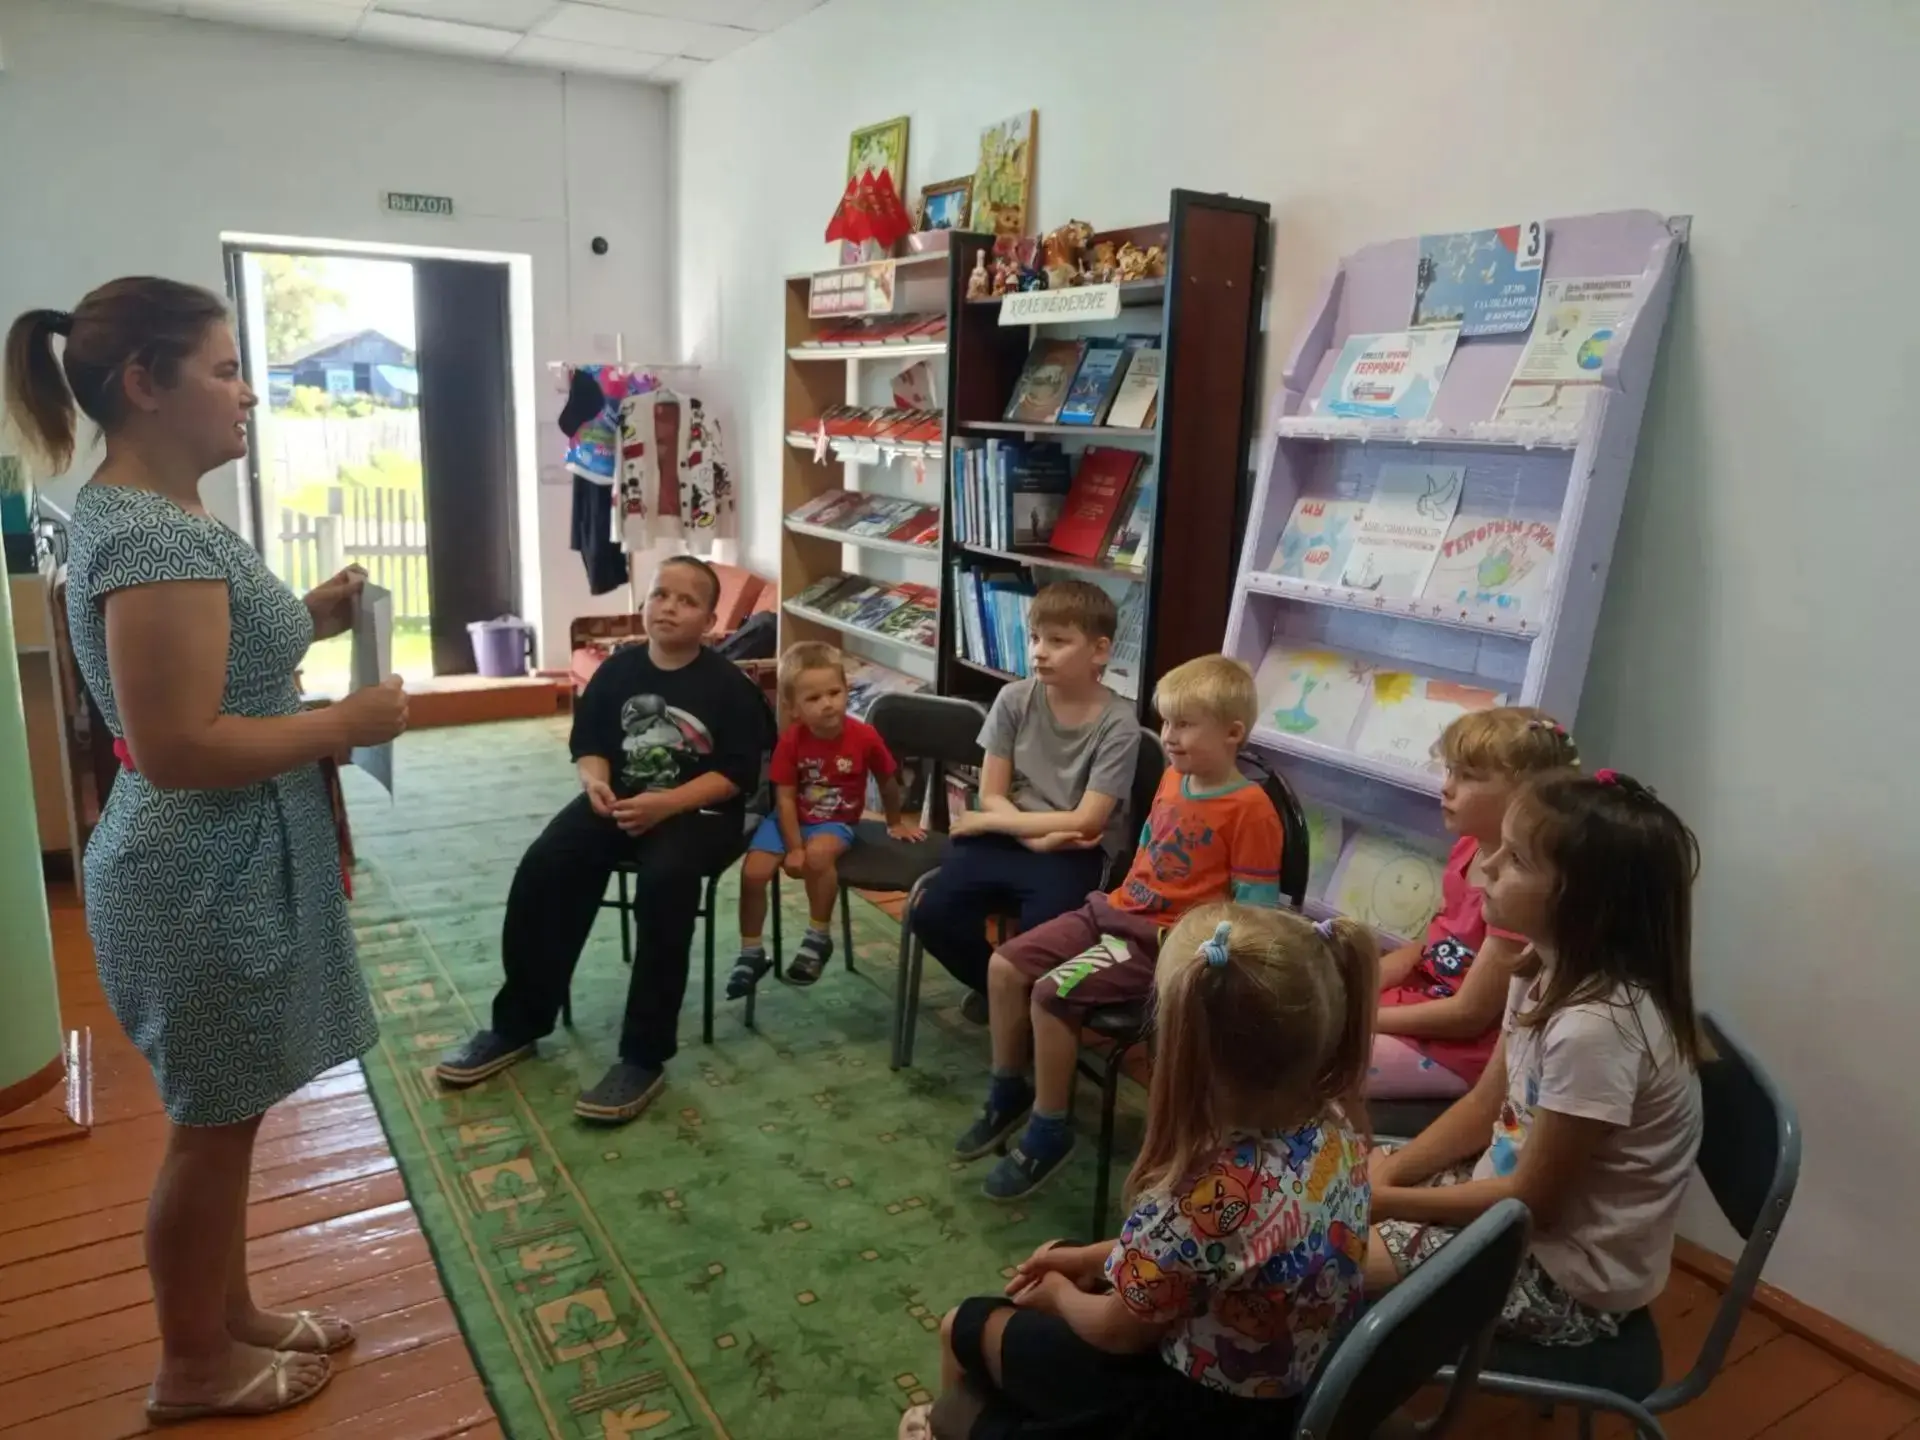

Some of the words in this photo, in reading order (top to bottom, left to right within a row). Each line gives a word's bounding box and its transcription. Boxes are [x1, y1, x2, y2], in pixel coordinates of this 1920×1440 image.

[390, 194, 451, 214] ВЫХОД
[1527, 221, 1541, 256] 3
[1300, 503, 1325, 517] МЫ
